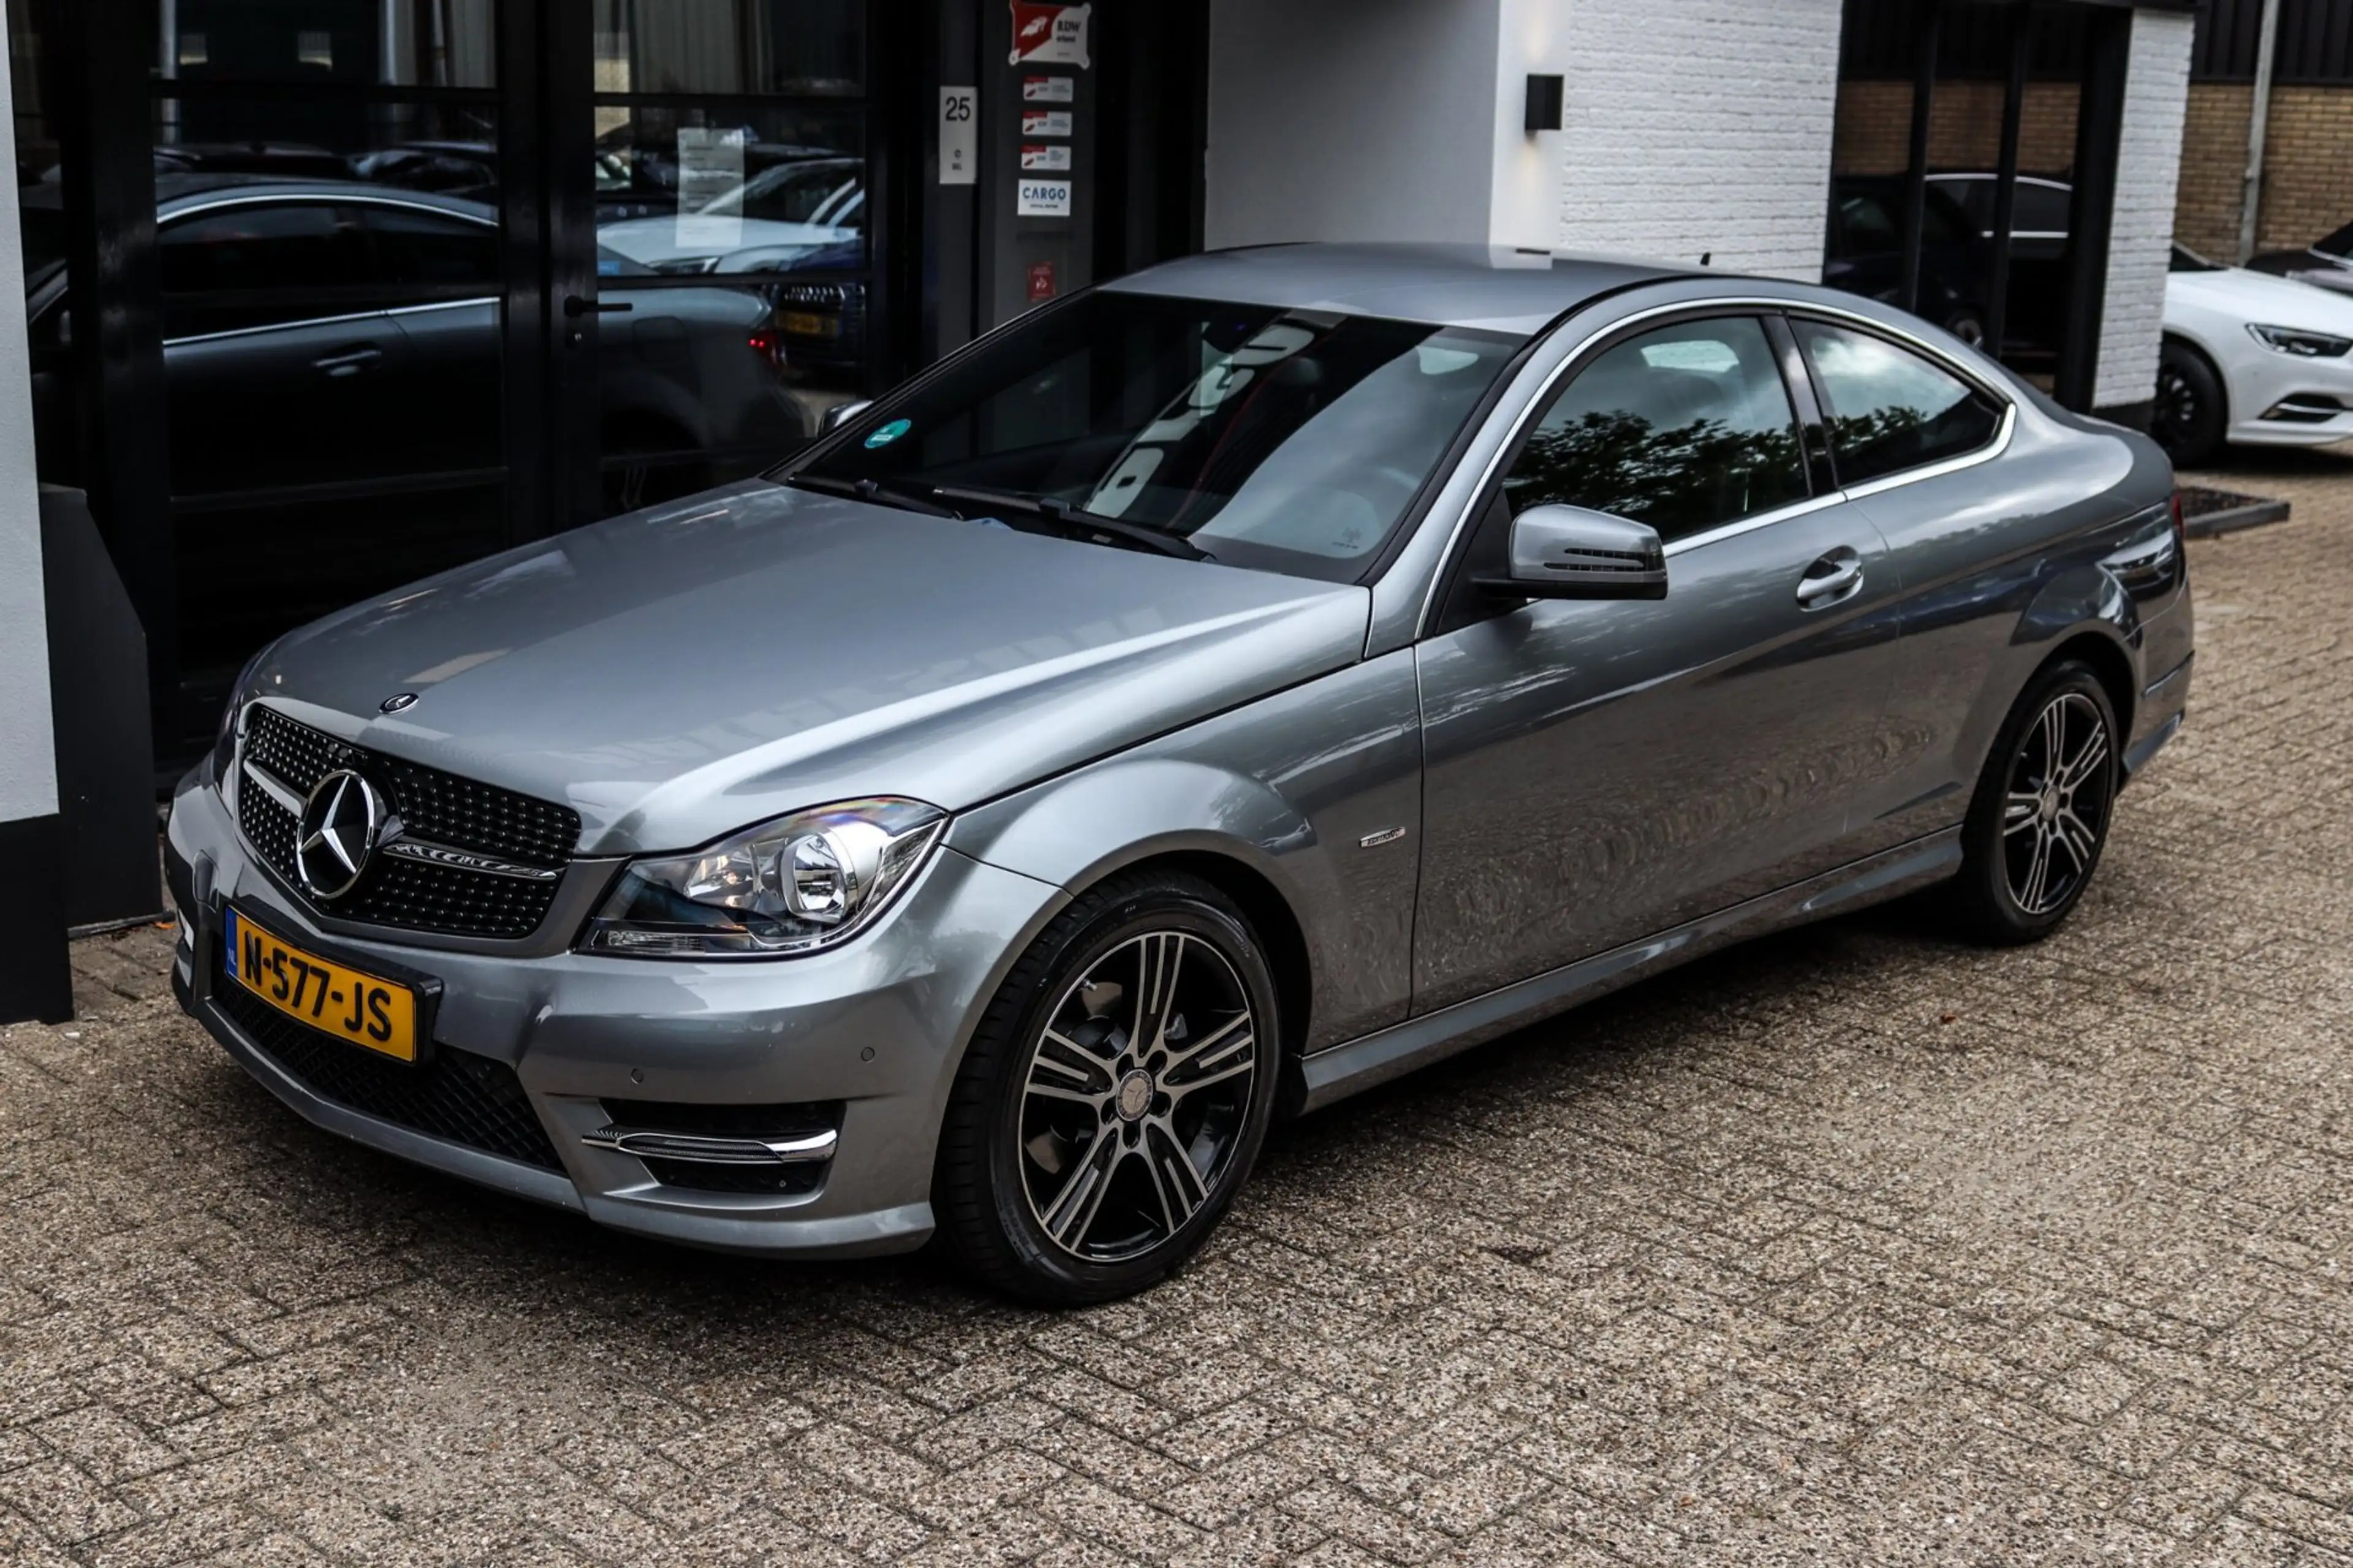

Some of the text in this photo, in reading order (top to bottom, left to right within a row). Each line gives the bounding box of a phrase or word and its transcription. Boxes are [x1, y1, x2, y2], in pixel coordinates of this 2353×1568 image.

[1058, 20, 1081, 32] RDW
[945, 96, 971, 121] 25
[1023, 186, 1066, 201] CARGO
[244, 930, 392, 1042] N-577-JS
